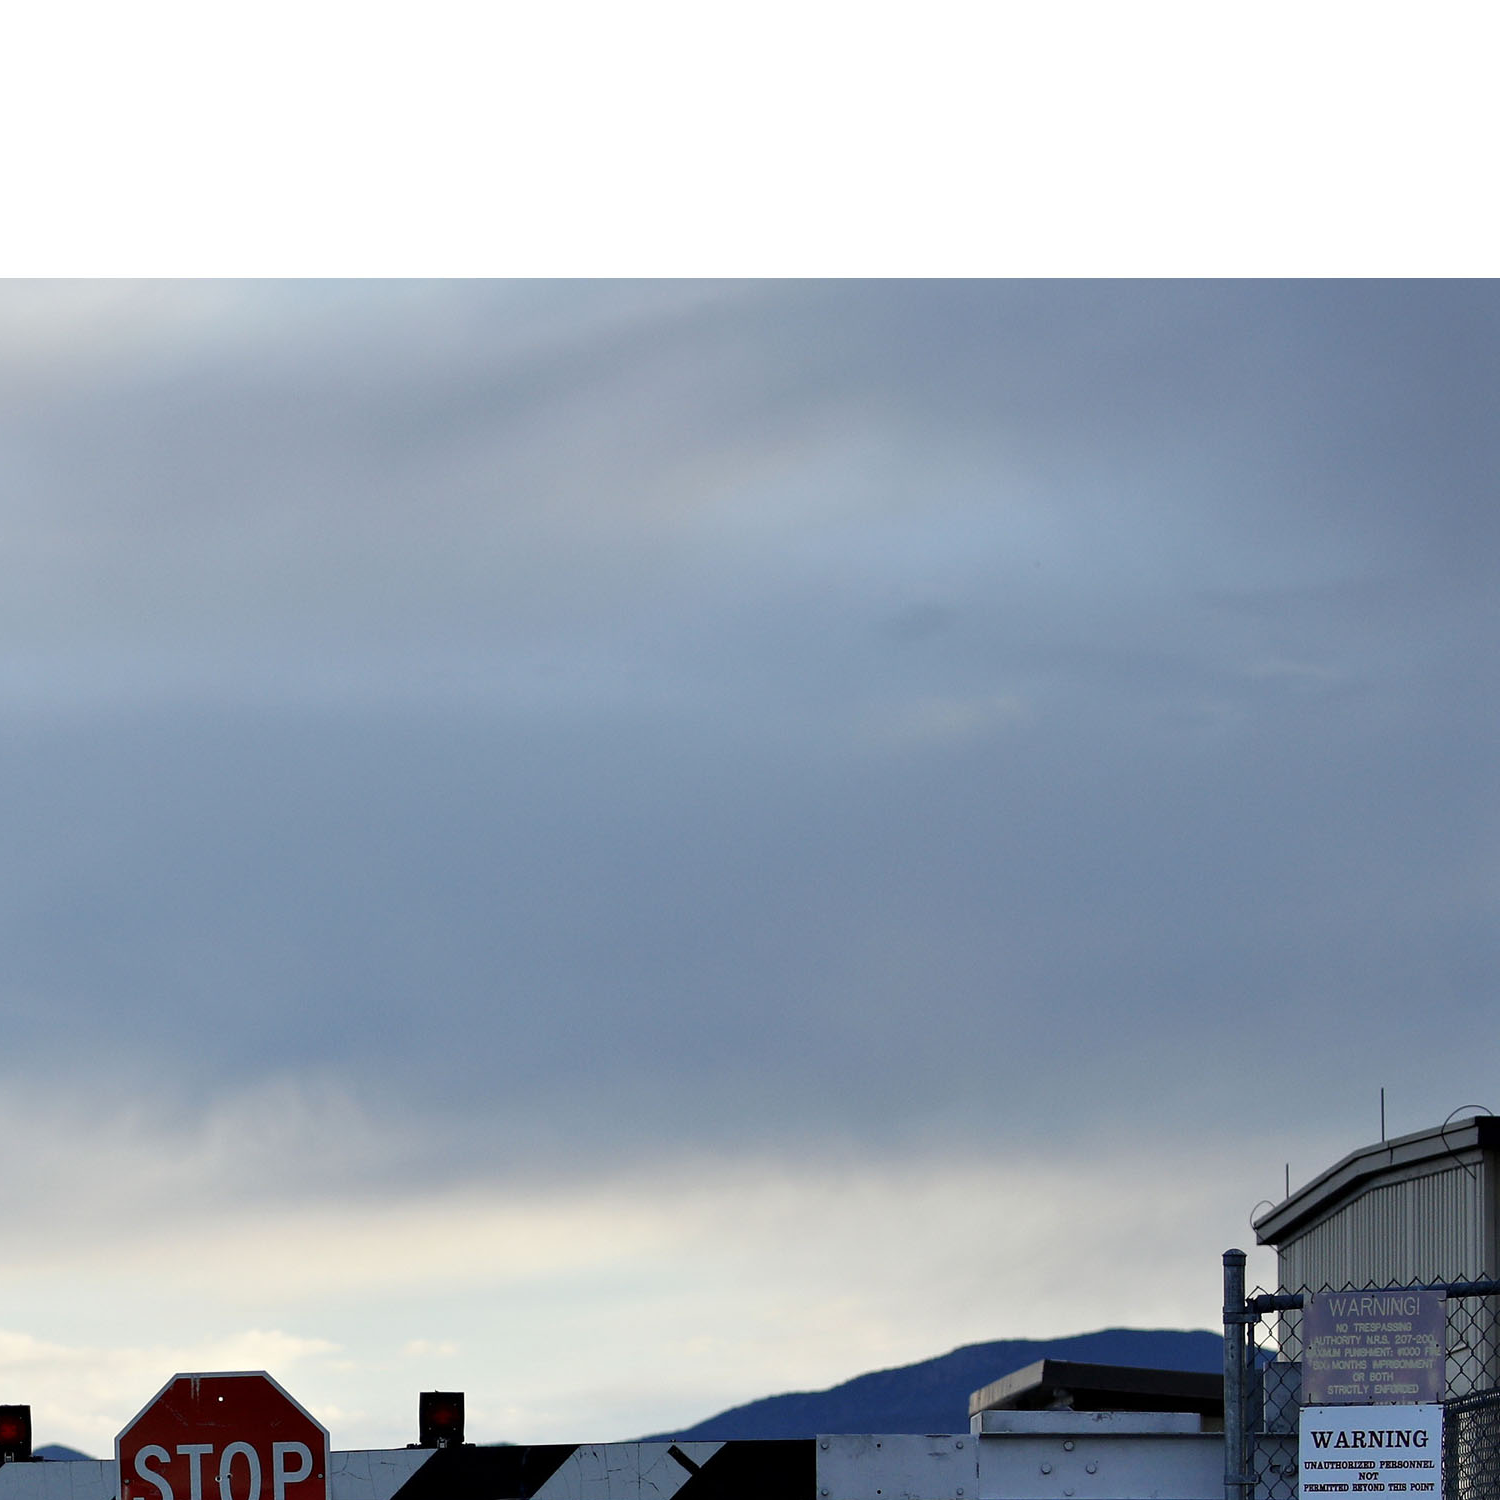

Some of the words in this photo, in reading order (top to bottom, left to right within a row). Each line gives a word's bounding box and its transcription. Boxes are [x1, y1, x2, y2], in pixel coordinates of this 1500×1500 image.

[1329, 1297, 1420, 1317] WARNING!
[1336, 1323, 1348, 1333] NO
[1354, 1322, 1412, 1333] TRESPASSING
[1315, 1336, 1361, 1345] AUTHORITY
[1331, 1360, 1367, 1369] MONTHS
[1372, 1360, 1434, 1369] IMPRISONMENT
[1352, 1372, 1365, 1382] OR
[1370, 1372, 1394, 1382] BOTH
[1328, 1385, 1370, 1395] STRICTLY
[1310, 1430, 1429, 1449] WARNING
[1304, 1461, 1376, 1470] UNAUTHORIZED
[1379, 1460, 1435, 1469] PERSONNEL
[1358, 1472, 1379, 1481] NOT
[1304, 1483, 1349, 1492] PERMITTED
[1352, 1483, 1385, 1492] BEYOND
[1388, 1483, 1407, 1492] THIS
[1410, 1483, 1435, 1491] POINT
